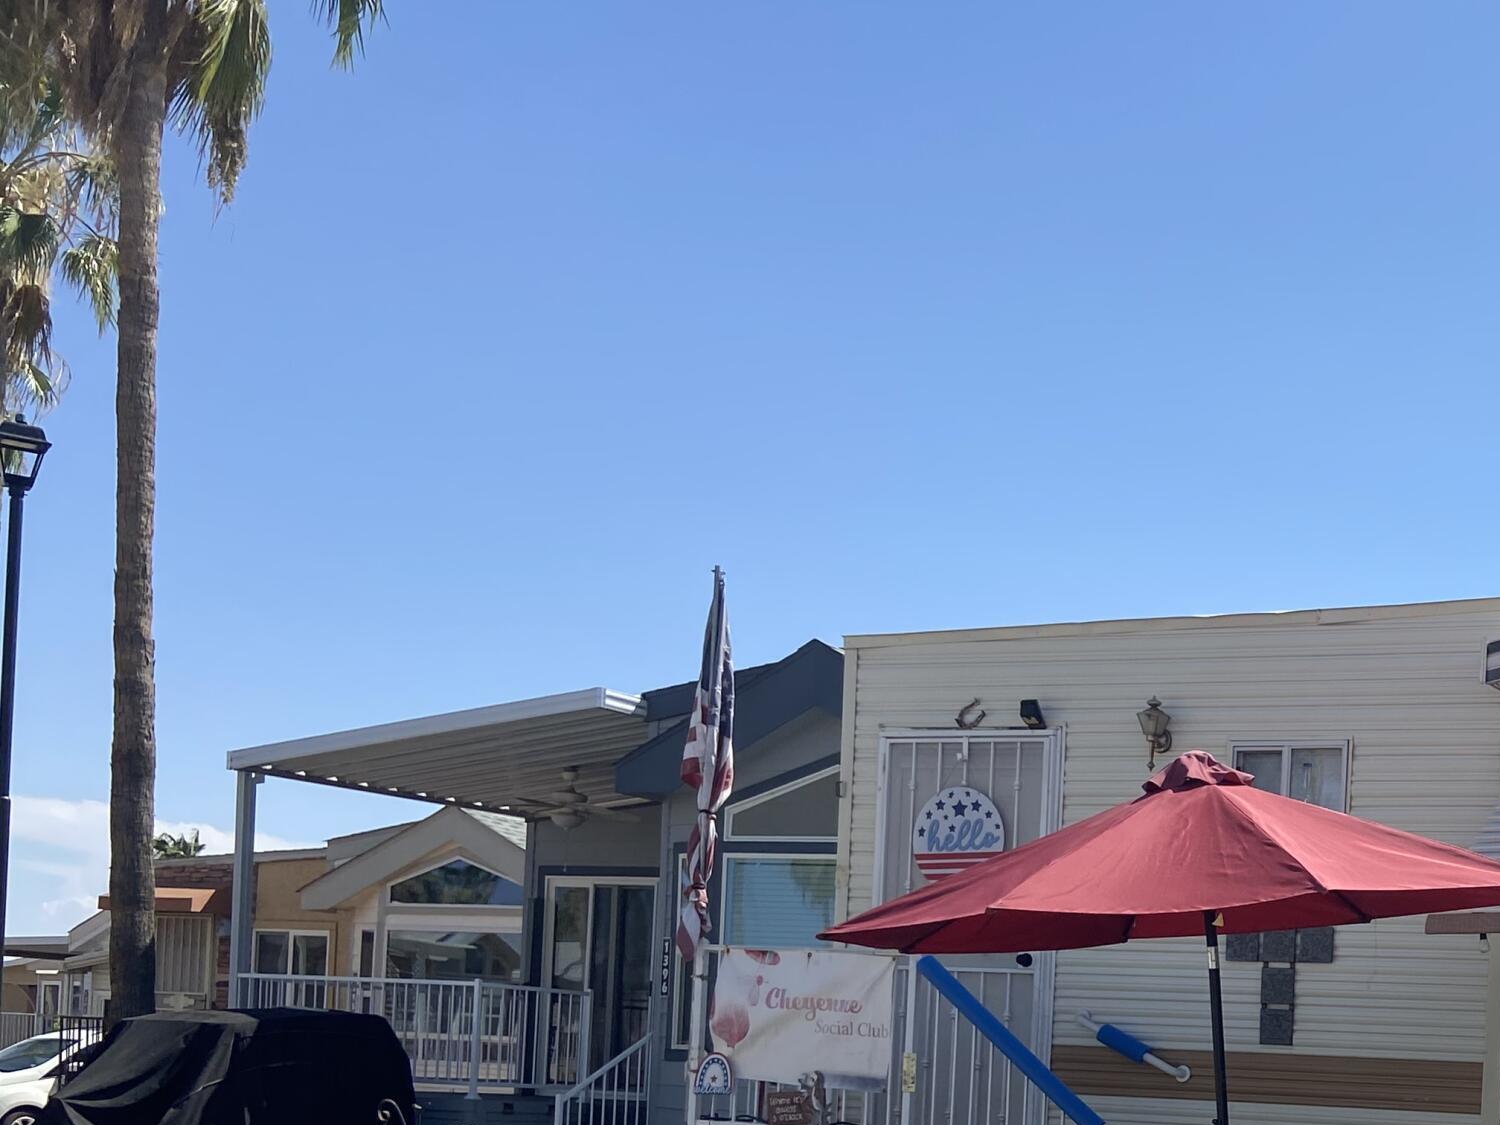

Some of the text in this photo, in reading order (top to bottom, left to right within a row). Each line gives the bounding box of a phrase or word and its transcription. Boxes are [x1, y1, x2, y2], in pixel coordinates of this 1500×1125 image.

[927, 819, 1000, 852] hello
[765, 987, 863, 1021] Cheyenne
[814, 1021, 888, 1039] Social Club
